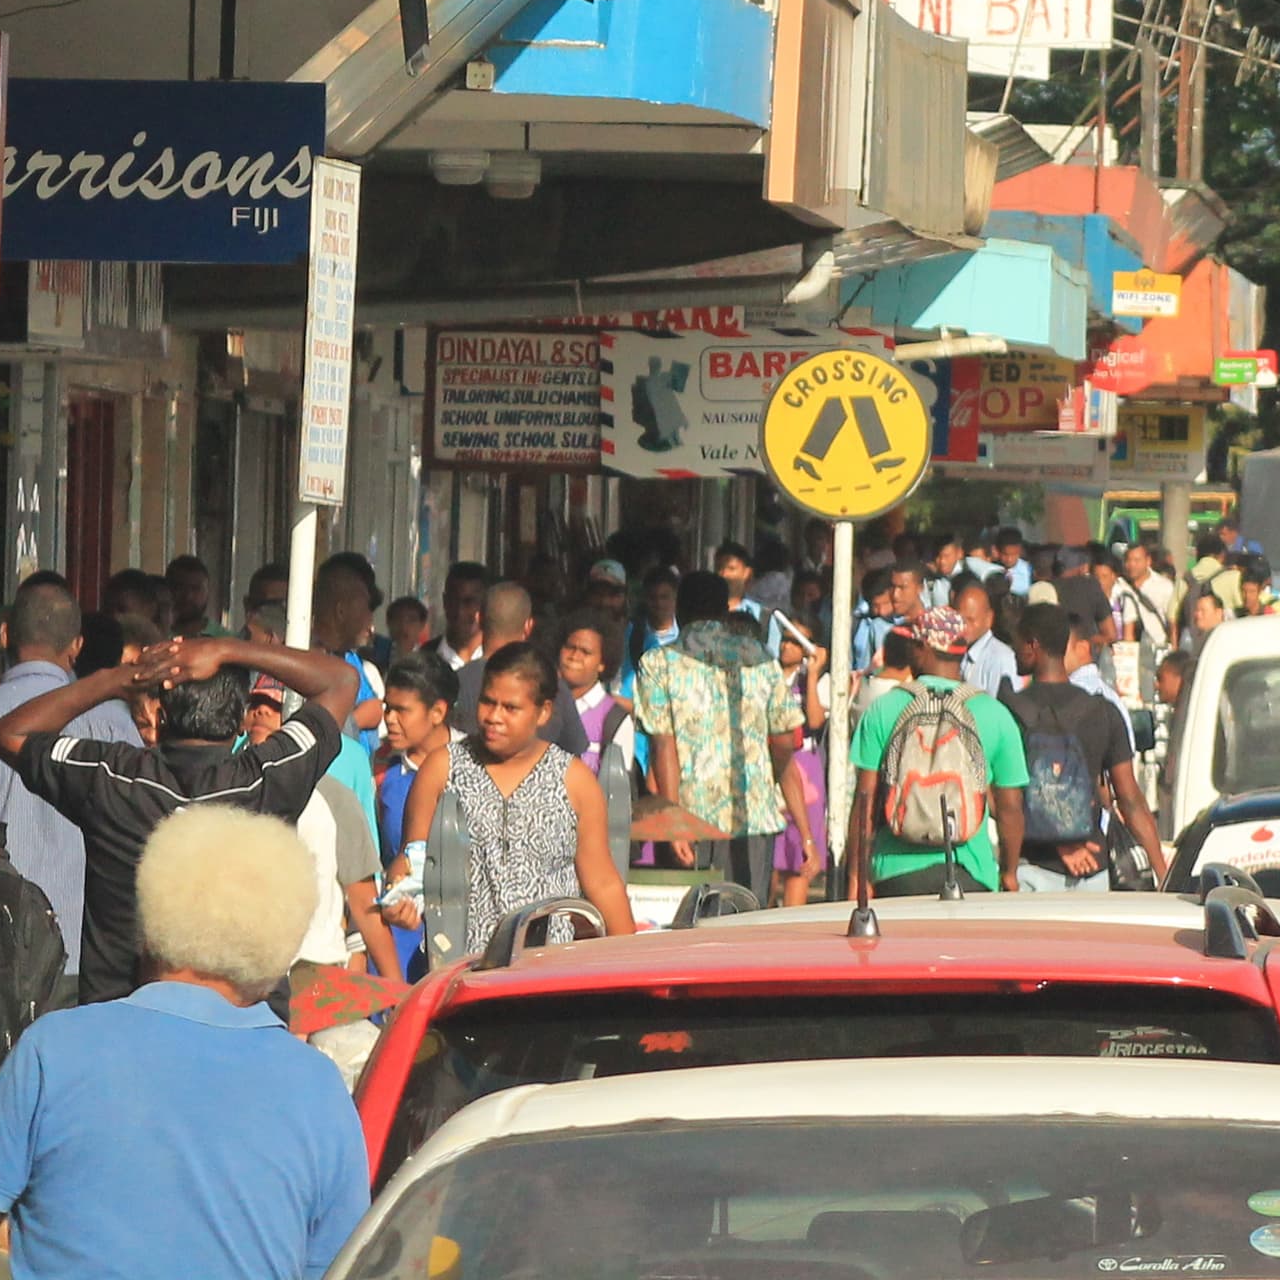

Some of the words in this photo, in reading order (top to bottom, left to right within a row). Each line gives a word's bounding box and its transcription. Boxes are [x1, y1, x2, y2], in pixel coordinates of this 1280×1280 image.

[231, 206, 279, 234] FIJI
[783, 358, 908, 409] CROSSING
[700, 445, 738, 460] Vale
